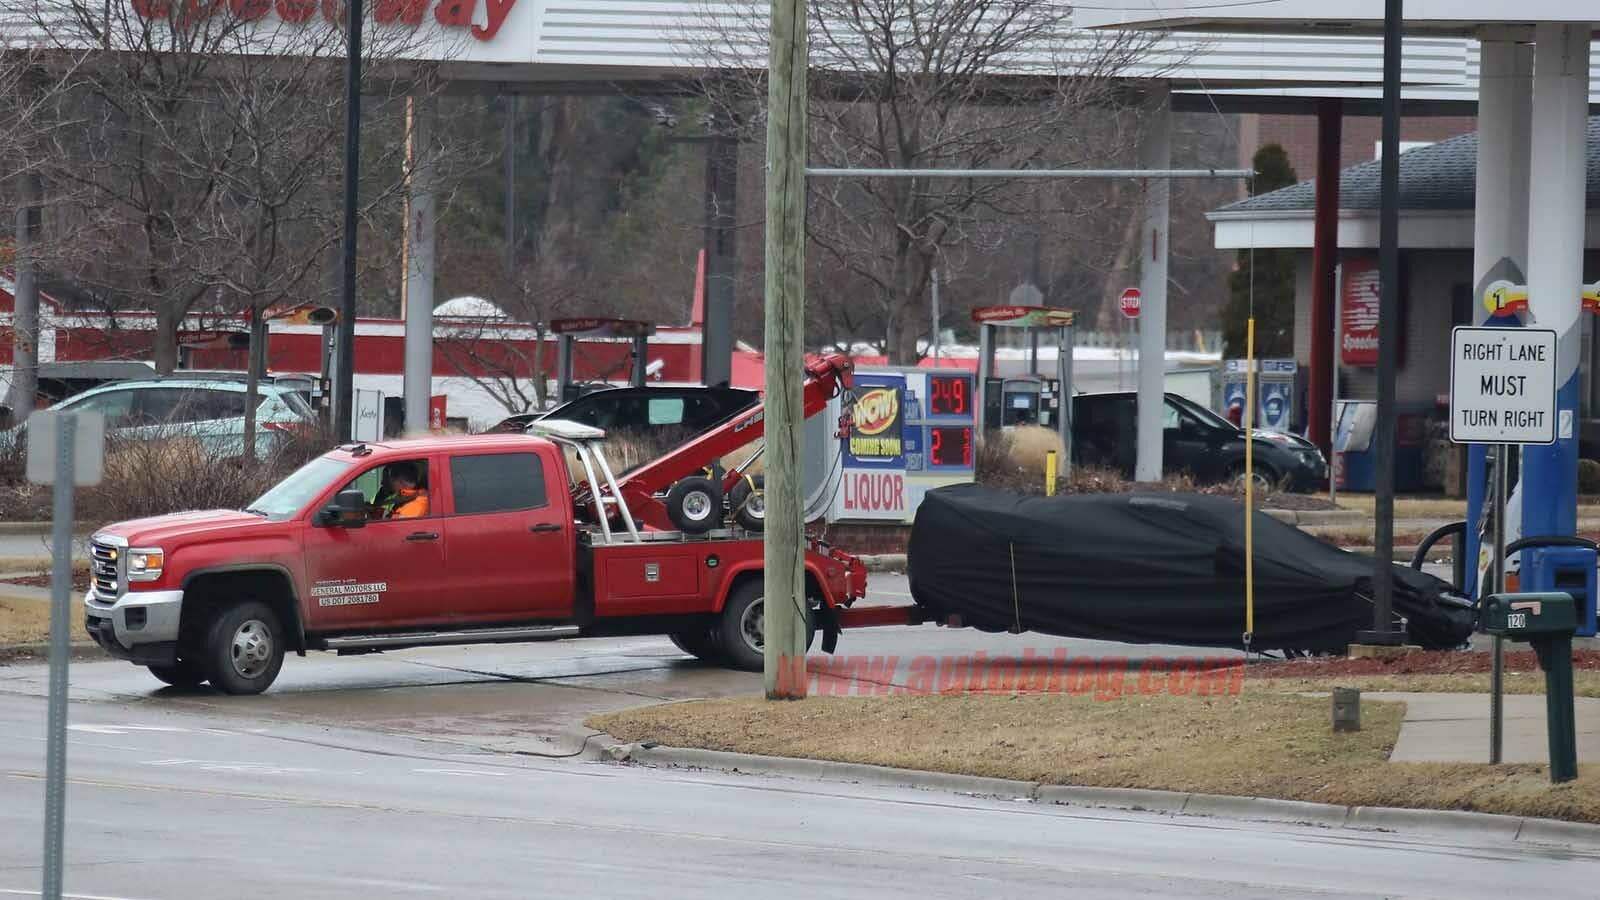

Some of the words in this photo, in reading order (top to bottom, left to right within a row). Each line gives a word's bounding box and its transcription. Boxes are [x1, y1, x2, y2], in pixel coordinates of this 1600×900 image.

[1463, 343, 1503, 361] RIGHT
[1509, 344, 1546, 361] LANE
[1480, 375, 1527, 396] MUST
[1462, 409, 1498, 427] TURN
[1504, 410, 1545, 428] RIGHT
[849, 437, 880, 456] COMING
[843, 472, 904, 512] LIQUOR
[344, 583, 373, 594] MOTORS
[373, 582, 386, 592] LLC
[332, 597, 346, 605] DOT
[1507, 614, 1526, 628] 120
